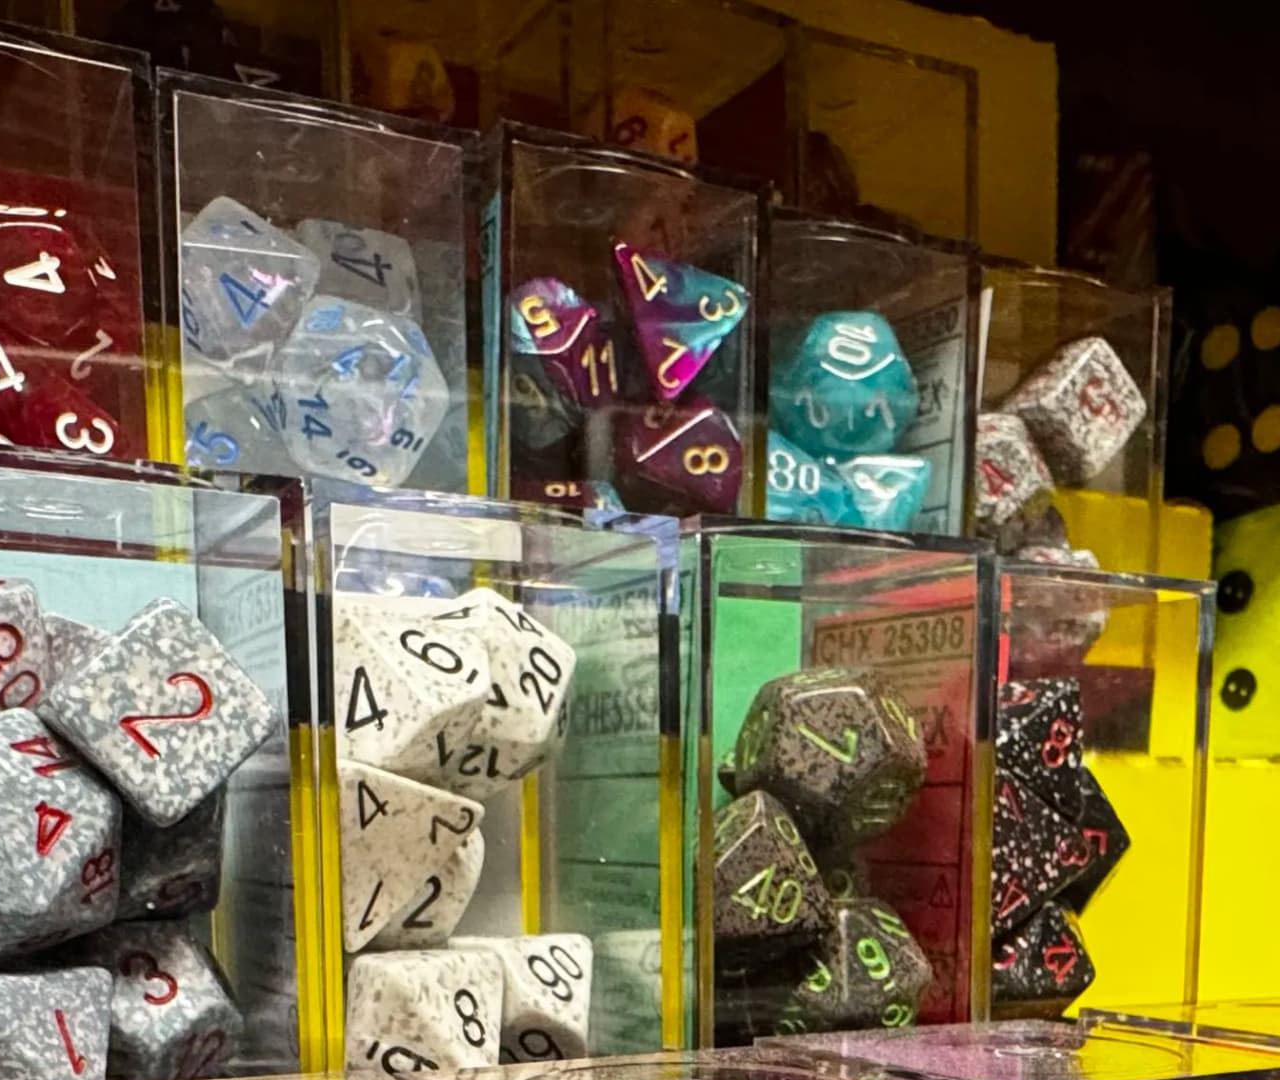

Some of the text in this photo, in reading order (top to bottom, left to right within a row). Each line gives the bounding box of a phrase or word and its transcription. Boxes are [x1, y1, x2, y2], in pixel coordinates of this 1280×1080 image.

[4, 252, 66, 293] 4
[631, 253, 668, 301] 4
[220, 272, 271, 331] 4
[521, 296, 561, 338] 5
[699, 290, 740, 322] 3
[582, 340, 617, 396] 11
[658, 337, 689, 389] 2
[828, 322, 878, 366] 10
[55, 412, 115, 455] 3
[192, 421, 241, 465] 5
[684, 444, 730, 475] 8
[768, 450, 821, 494] 80
[821, 615, 966, 667] CHX 25308
[345, 665, 389, 732] 4
[520, 646, 563, 715] 20
[119, 671, 214, 760] 2
[1041, 718, 1073, 769] 8
[34, 800, 73, 857] 4
[357, 780, 389, 830] 4
[429, 806, 475, 846] 2
[358, 880, 384, 932] 1
[401, 875, 442, 929] 2
[732, 864, 803, 925] 40
[122, 950, 179, 1006] 3
[454, 988, 486, 1048] 8
